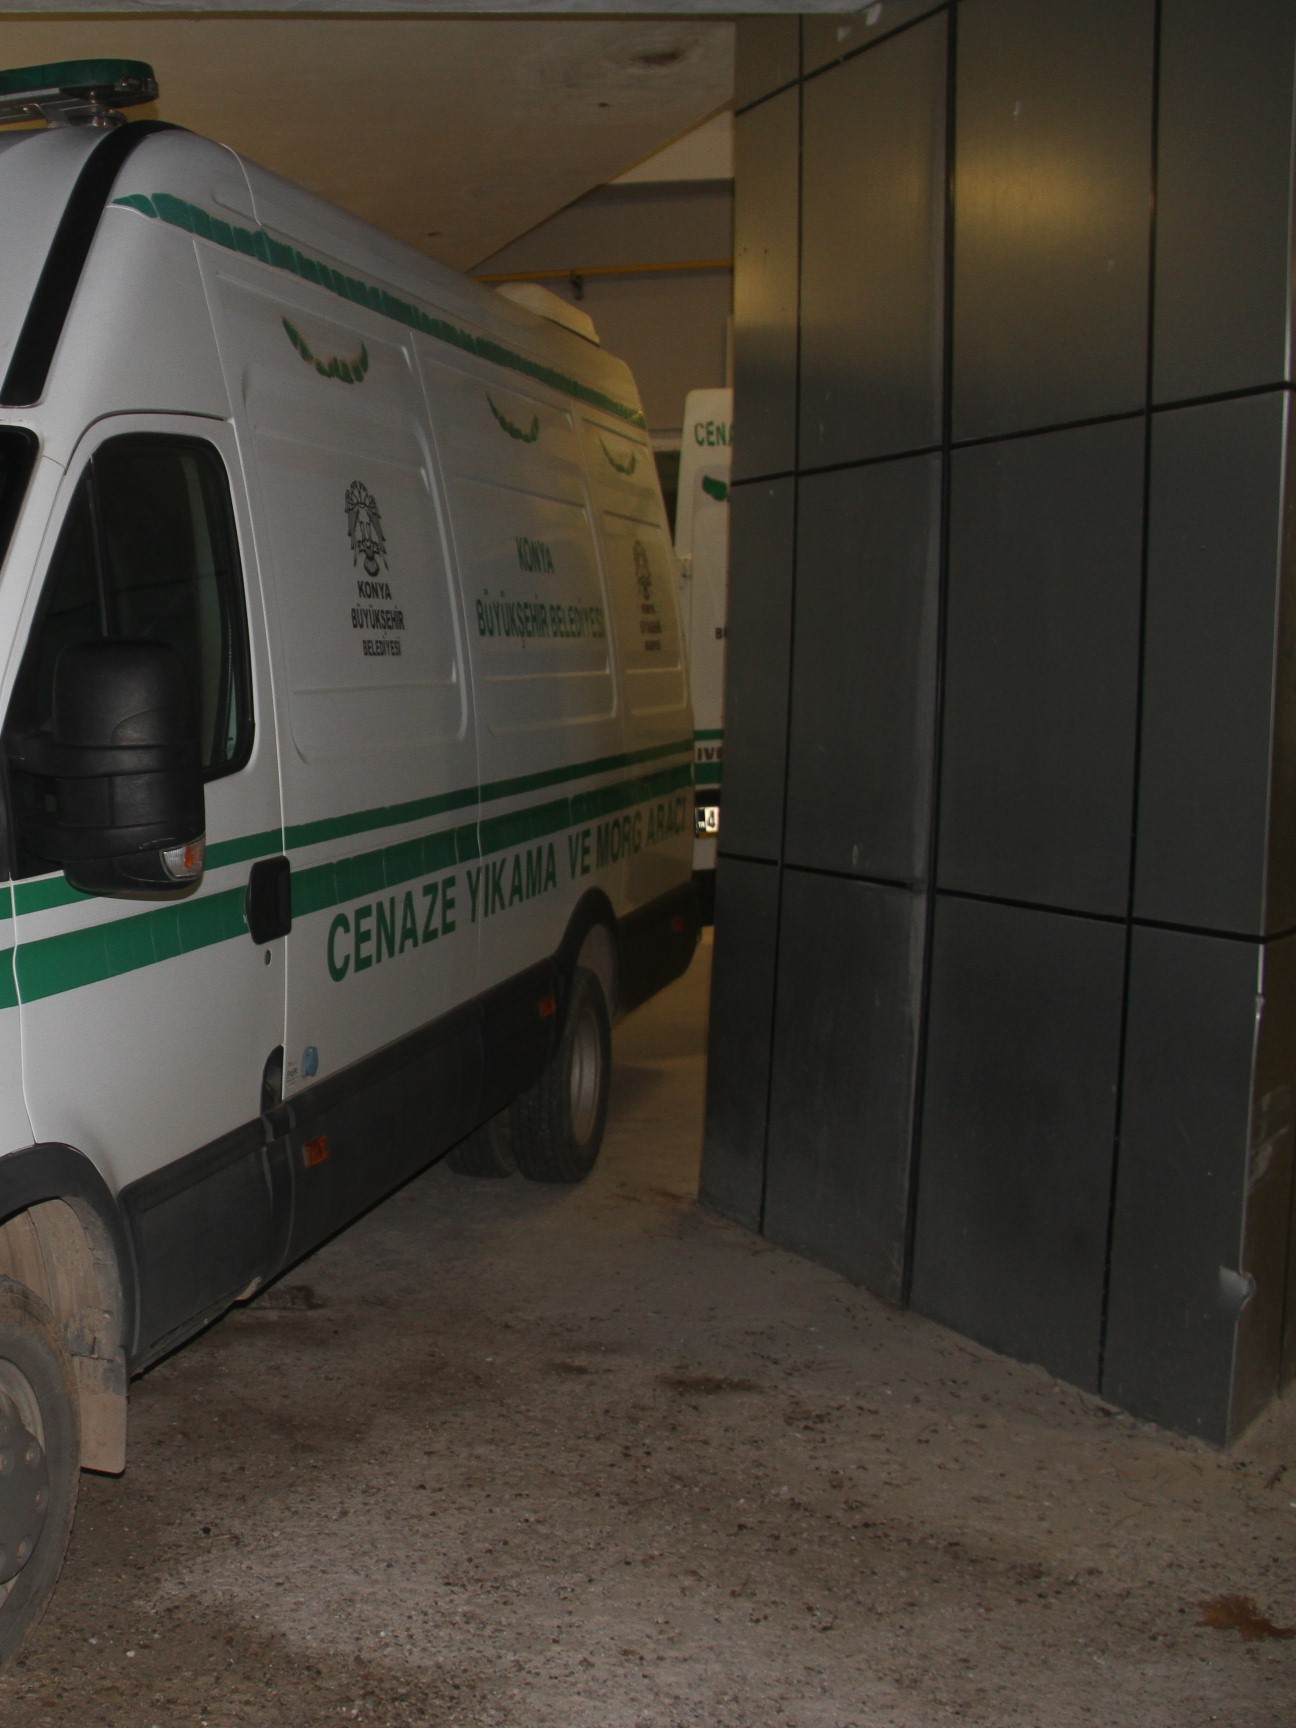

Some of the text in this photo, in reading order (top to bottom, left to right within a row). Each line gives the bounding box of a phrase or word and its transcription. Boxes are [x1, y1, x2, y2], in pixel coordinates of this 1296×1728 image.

[516, 536, 555, 574] KONYA
[357, 580, 392, 600] KONYA
[362, 636, 401, 656] BELEDİYESİ
[327, 797, 687, 982] CENAZE YIKAMA VE MORG ARACI
